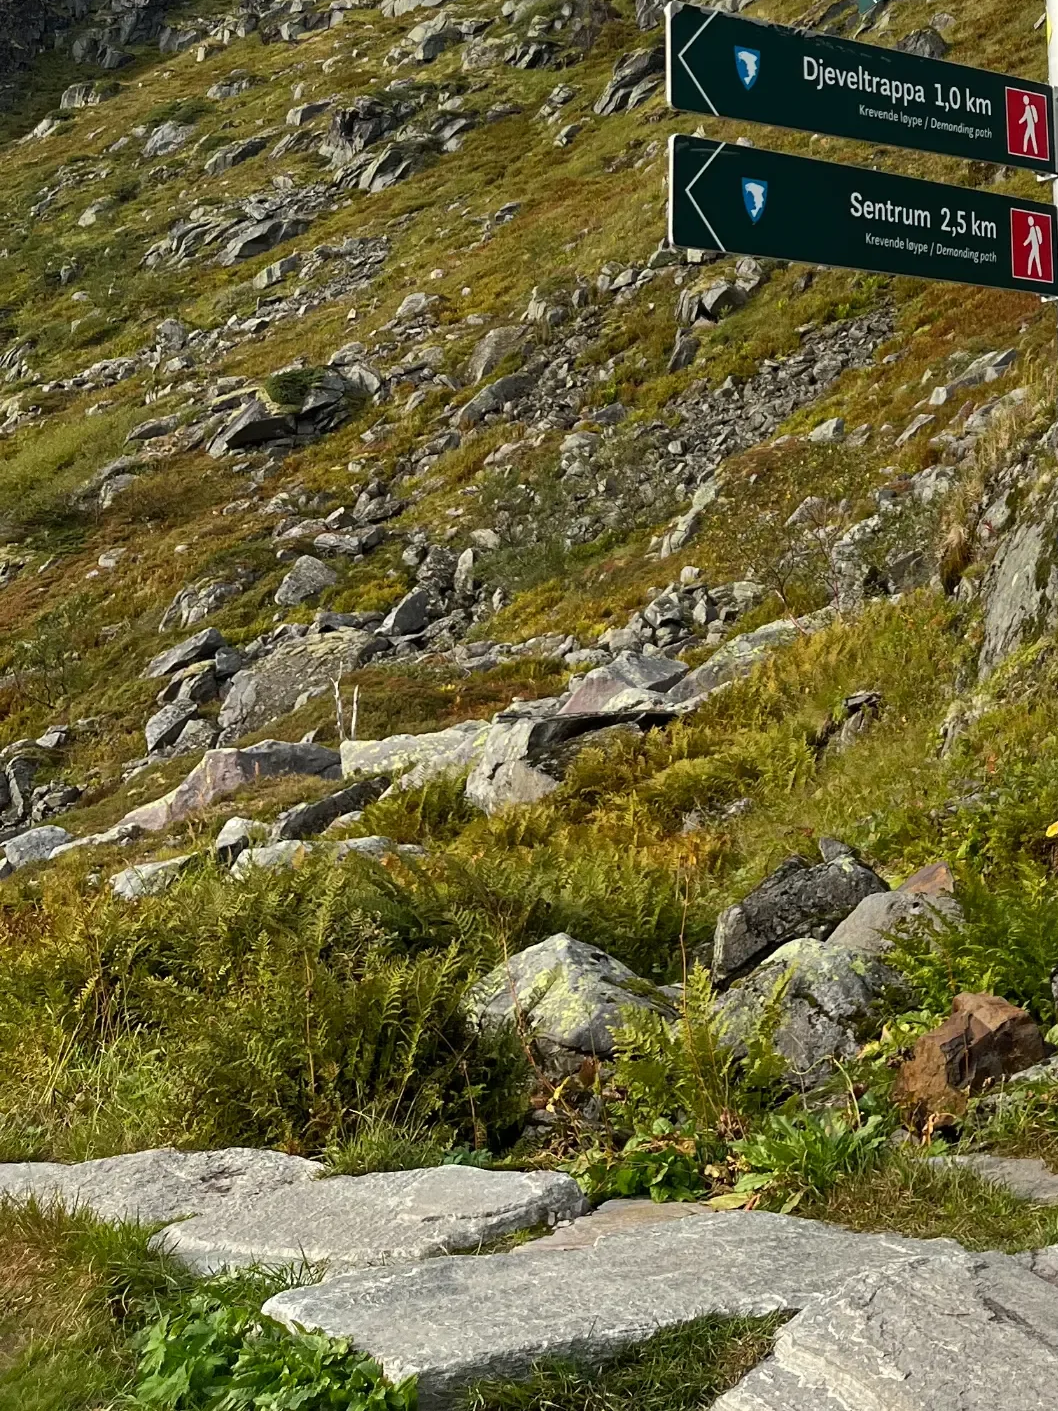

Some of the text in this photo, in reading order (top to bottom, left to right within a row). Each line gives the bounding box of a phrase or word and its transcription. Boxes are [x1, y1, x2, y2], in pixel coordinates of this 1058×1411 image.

[802, 55, 992, 116] Djeveltrappa 1,0 km
[858, 104, 899, 122] Krevende
[900, 111, 923, 128] løype
[930, 117, 974, 139] Demanding
[974, 126, 993, 140] path
[850, 191, 997, 239] Sentrum 2,5 km
[865, 232, 905, 250] Krevende
[906, 238, 929, 255] løype
[936, 243, 979, 264] Demanding
[979, 251, 997, 264] path
